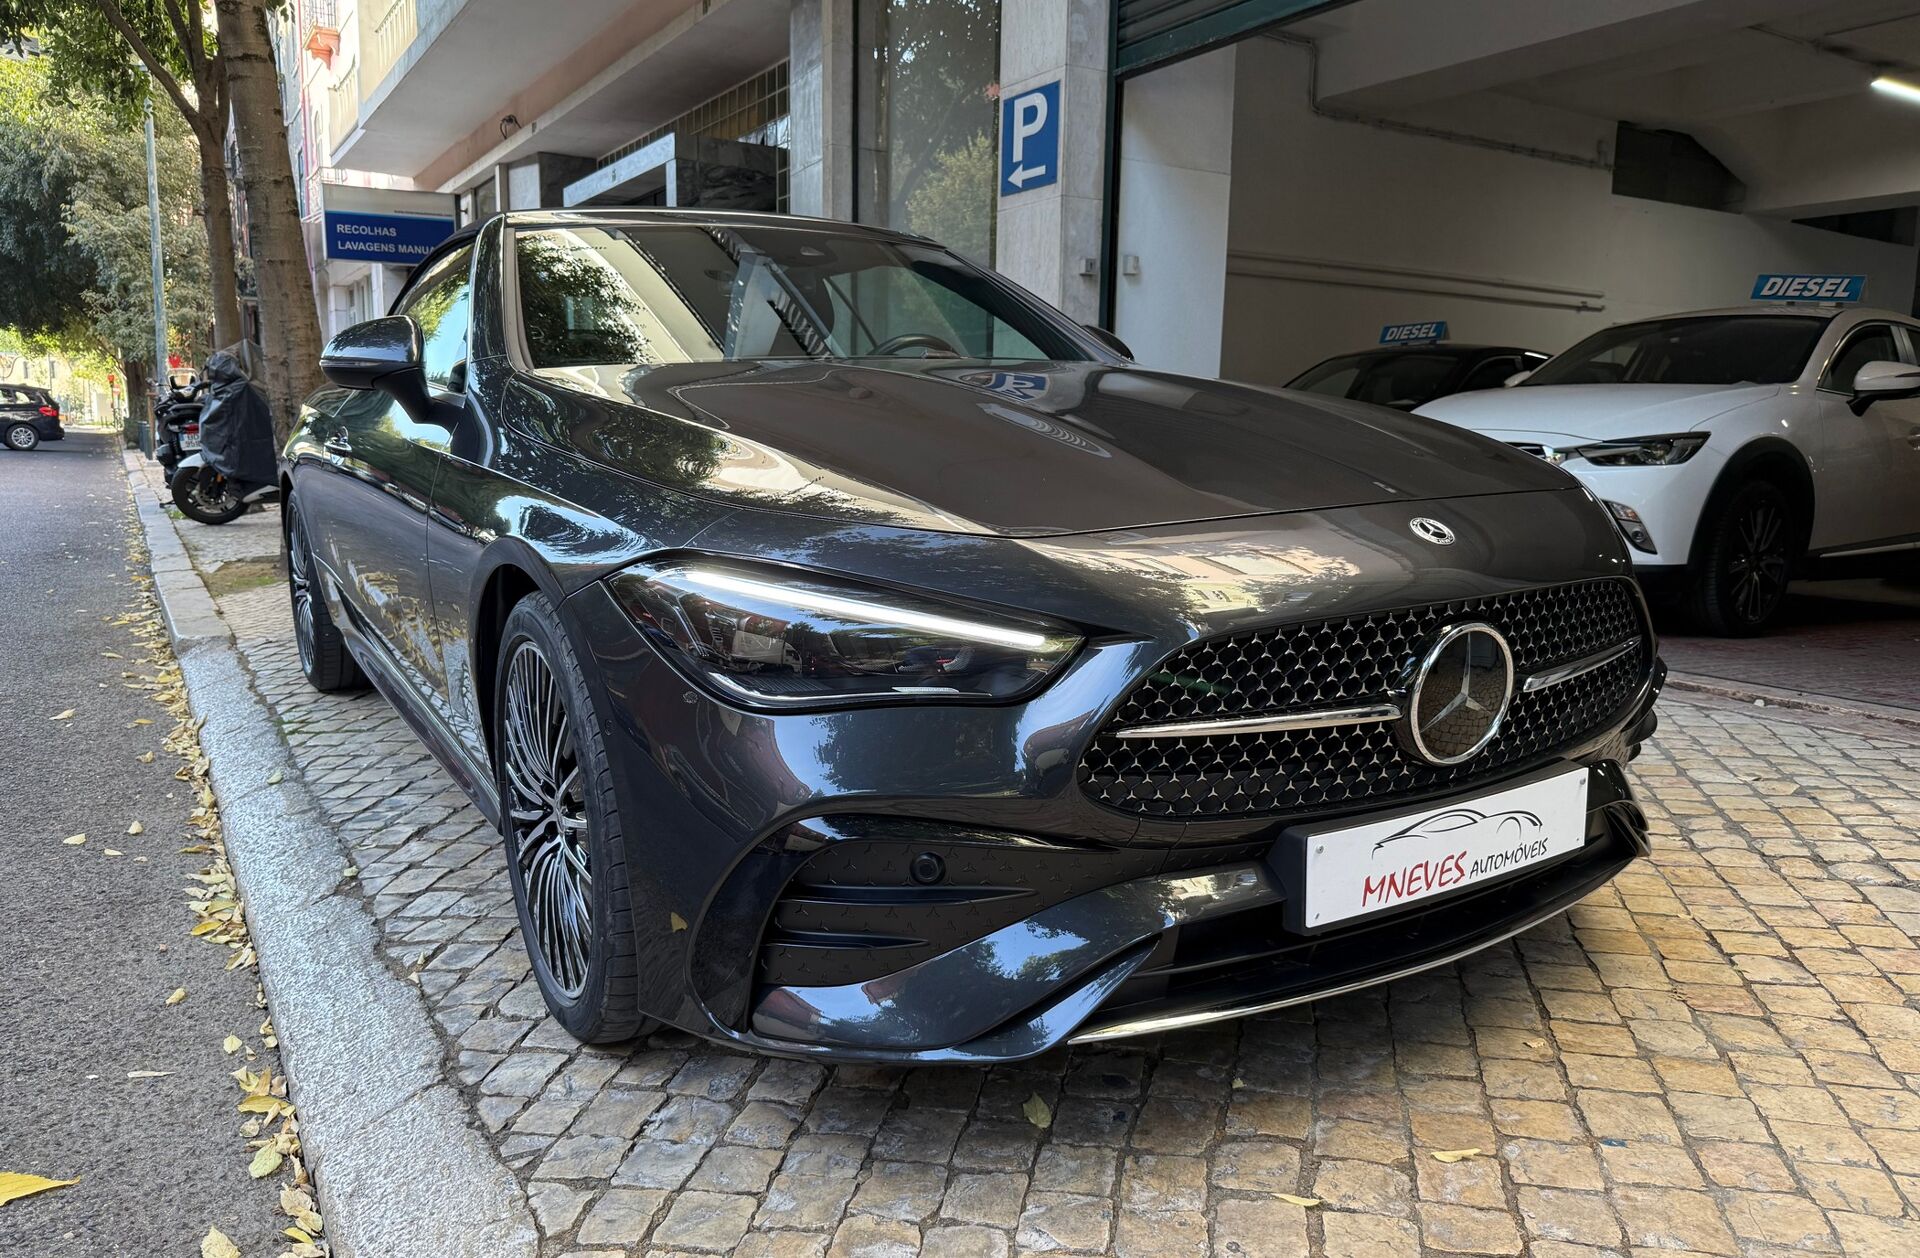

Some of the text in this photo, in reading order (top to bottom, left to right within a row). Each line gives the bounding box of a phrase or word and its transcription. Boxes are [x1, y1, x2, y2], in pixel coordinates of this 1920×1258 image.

[1013, 92, 1047, 163] P
[336, 224, 397, 237] RECOLHAS
[338, 241, 396, 253] LAVAGENS
[1760, 277, 1851, 298] DIESEL
[1385, 323, 1437, 341] DIESEL
[1362, 837, 1549, 908] MNEVES AUTOMÓVEIS
